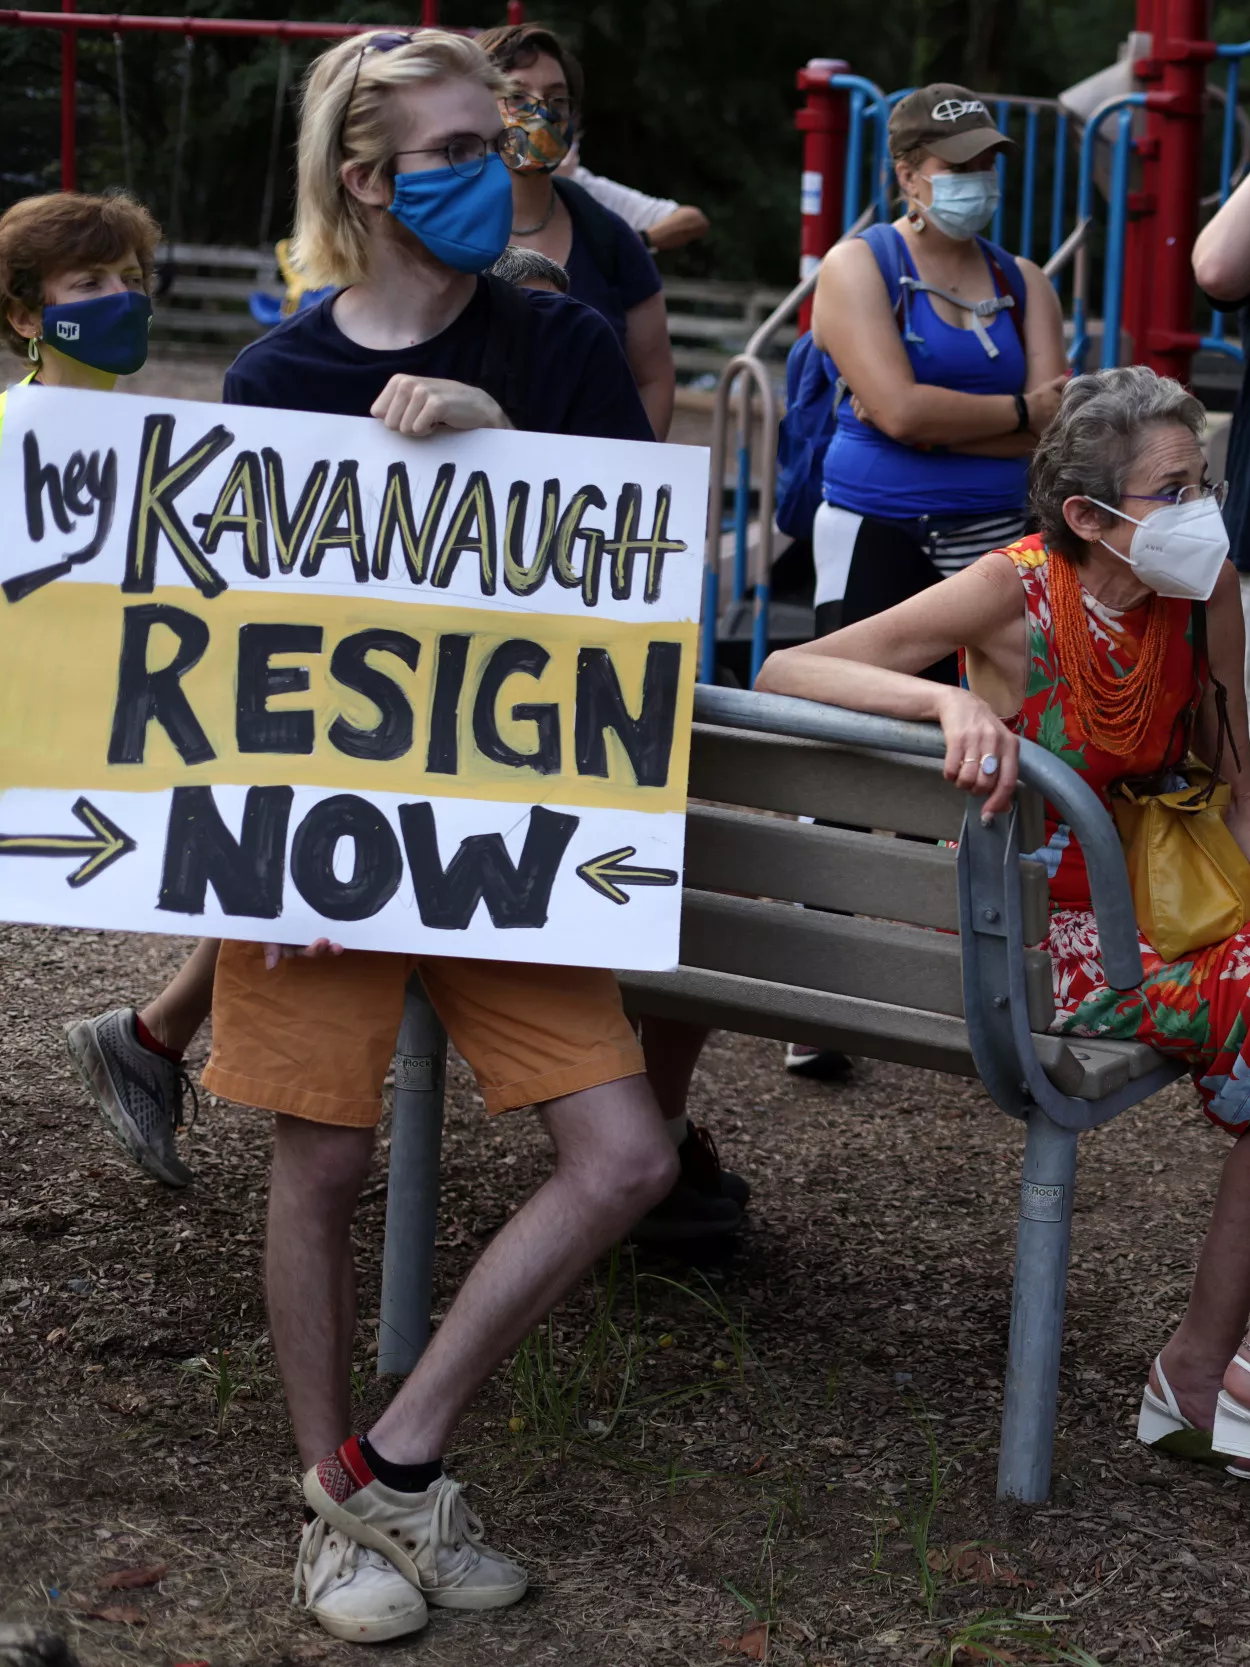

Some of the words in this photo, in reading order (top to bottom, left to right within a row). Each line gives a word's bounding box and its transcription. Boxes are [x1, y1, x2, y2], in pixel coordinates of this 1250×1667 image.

[57, 322, 78, 338] hjf
[2, 430, 118, 602] hey
[121, 413, 687, 607] KAVANAUGH
[107, 603, 682, 788] RESIGN
[158, 784, 580, 931] NOW
